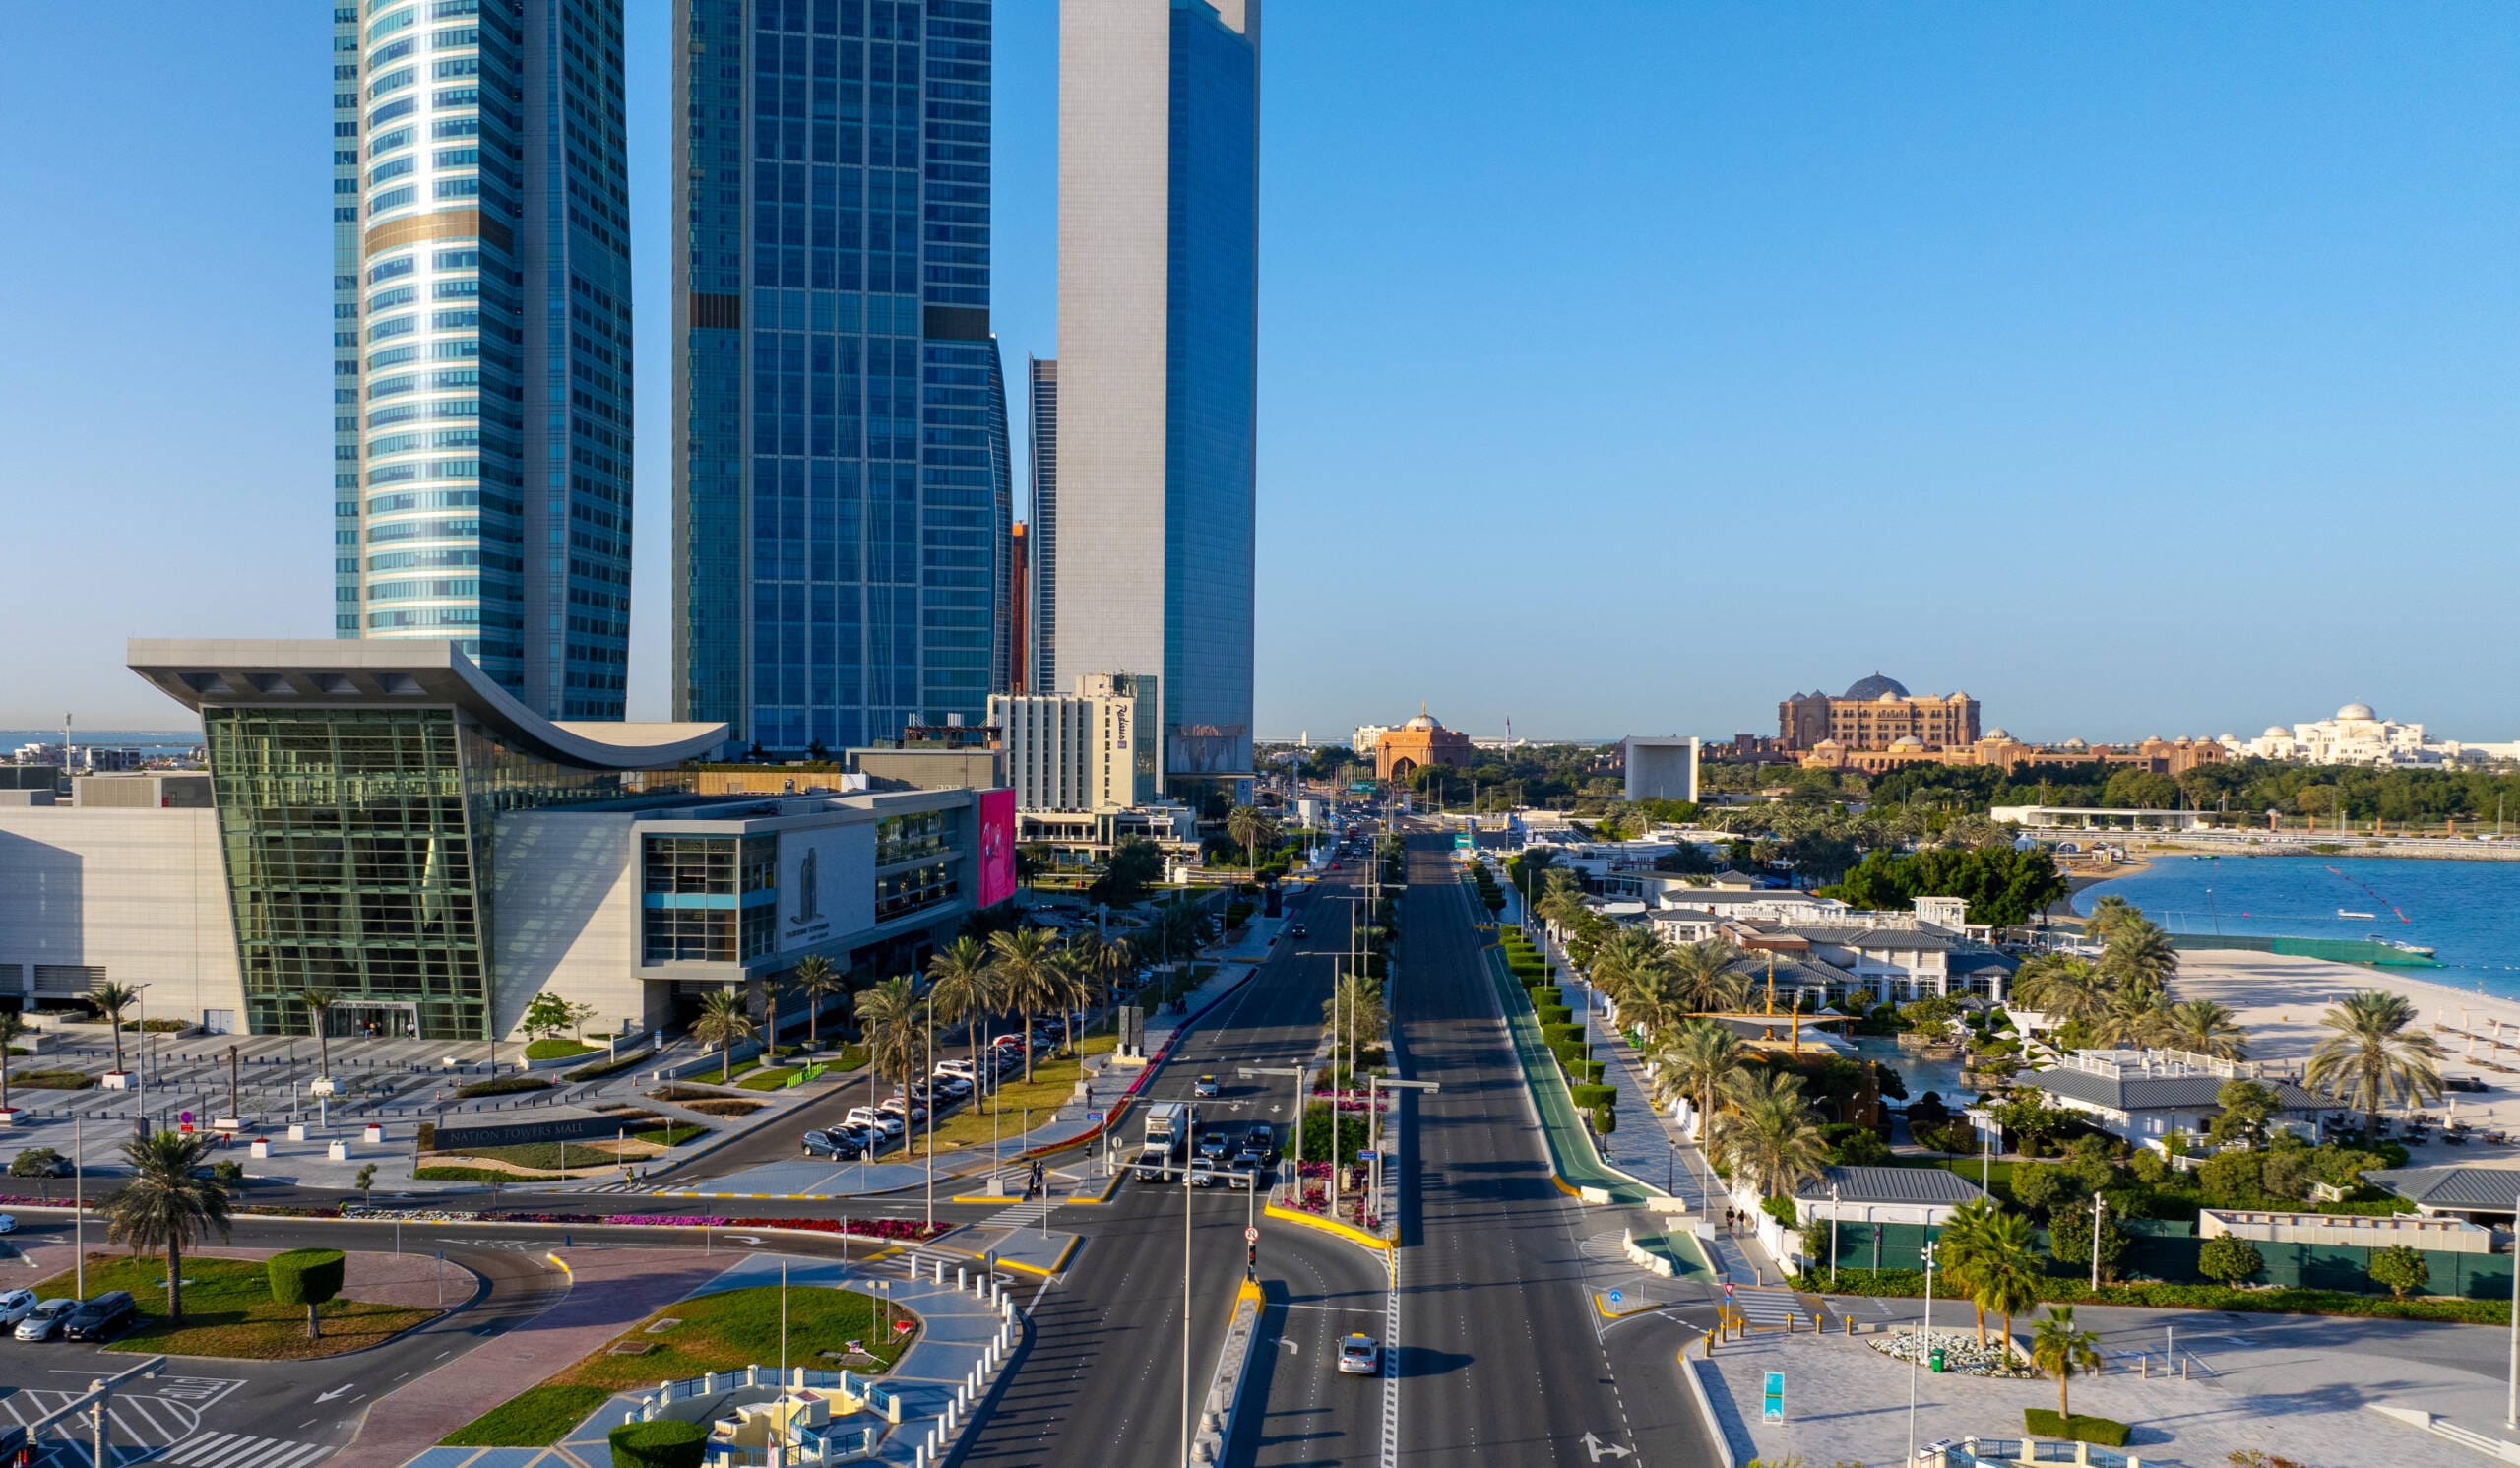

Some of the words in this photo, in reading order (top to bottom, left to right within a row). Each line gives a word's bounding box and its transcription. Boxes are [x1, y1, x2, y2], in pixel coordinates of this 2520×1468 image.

[450, 1129, 499, 1143] NATION
[503, 1125, 551, 1139] TOWERS
[554, 1122, 584, 1135] MALL
